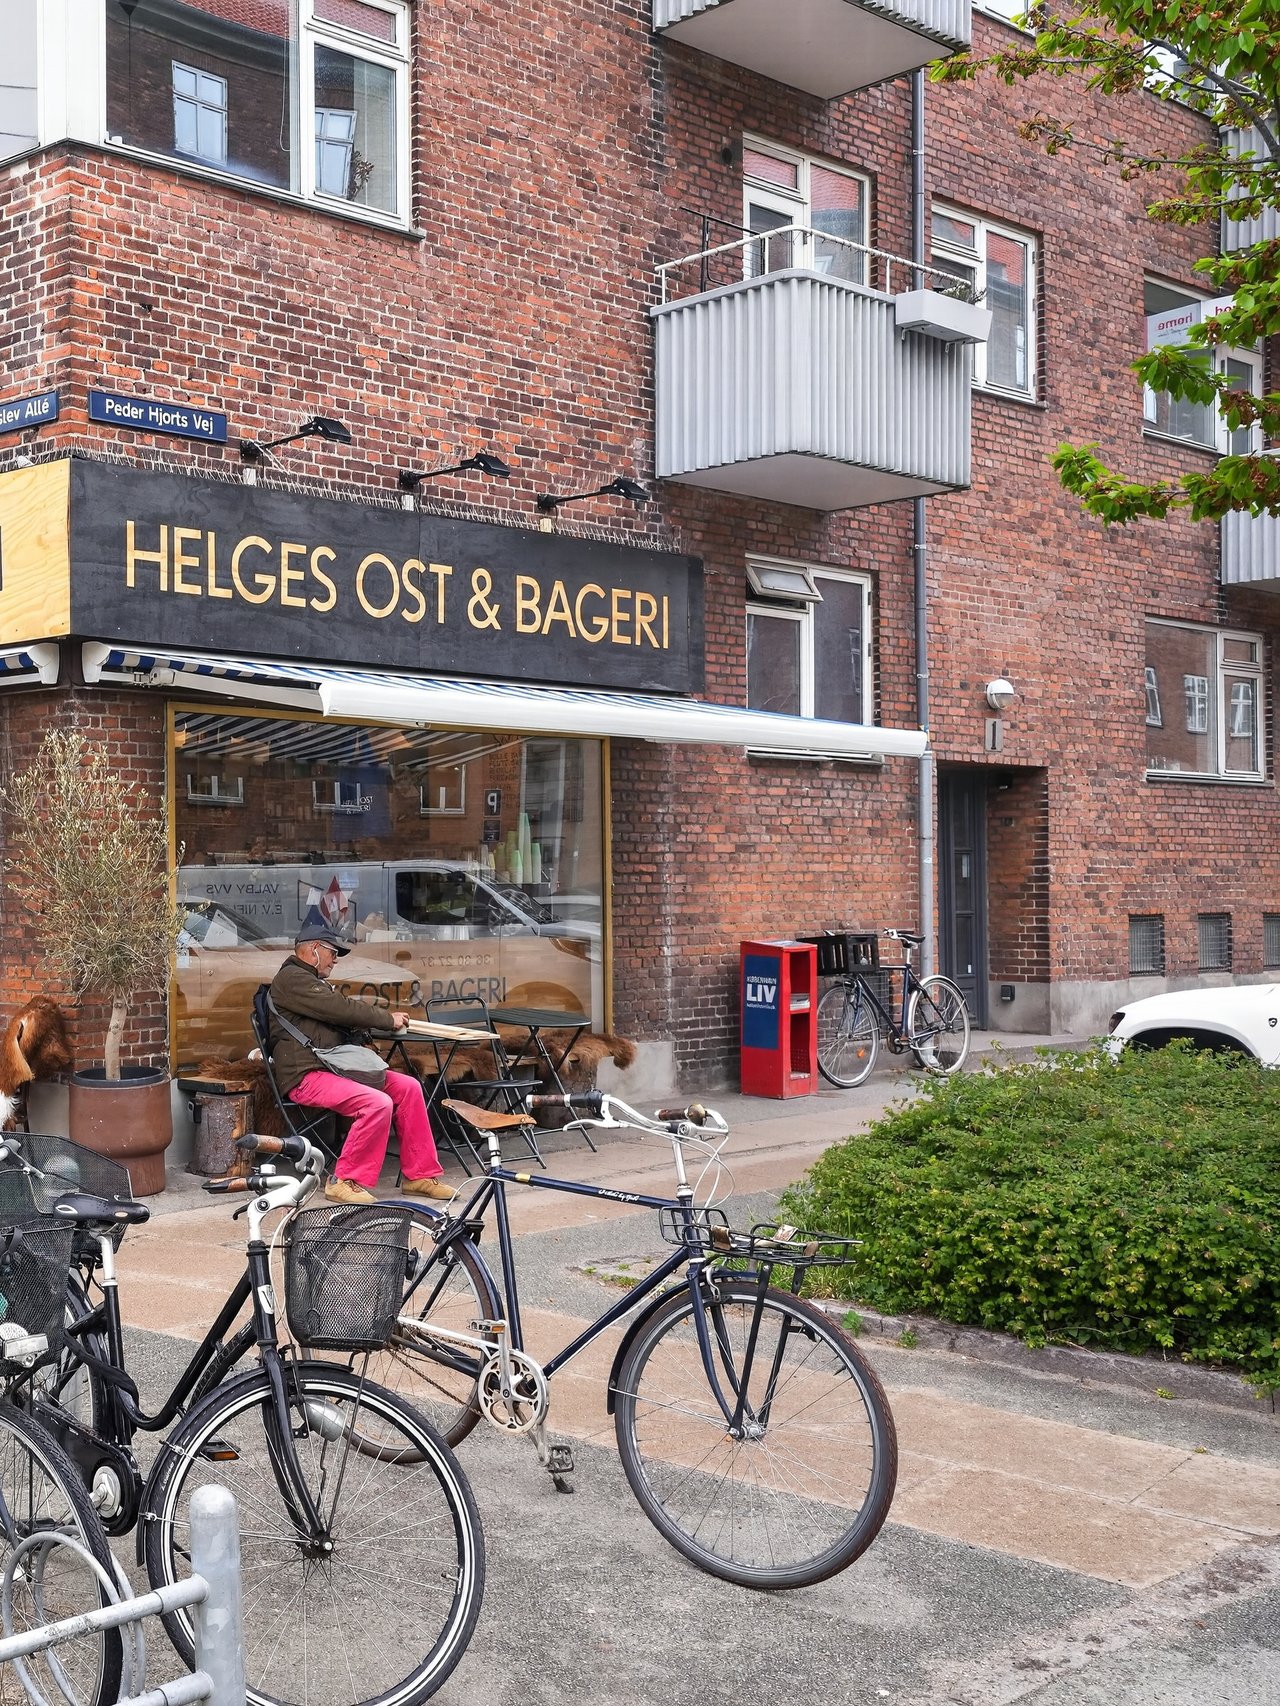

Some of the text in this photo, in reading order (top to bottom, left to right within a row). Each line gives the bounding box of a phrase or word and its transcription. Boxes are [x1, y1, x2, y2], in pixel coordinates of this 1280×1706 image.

[25, 398, 50, 420] Allé
[105, 398, 214, 435] Peder Hjorts Vej
[125, 519, 669, 650] HELGES OST & BAGERI
[991, 720, 997, 750] 1
[746, 983, 777, 1004] LIV
